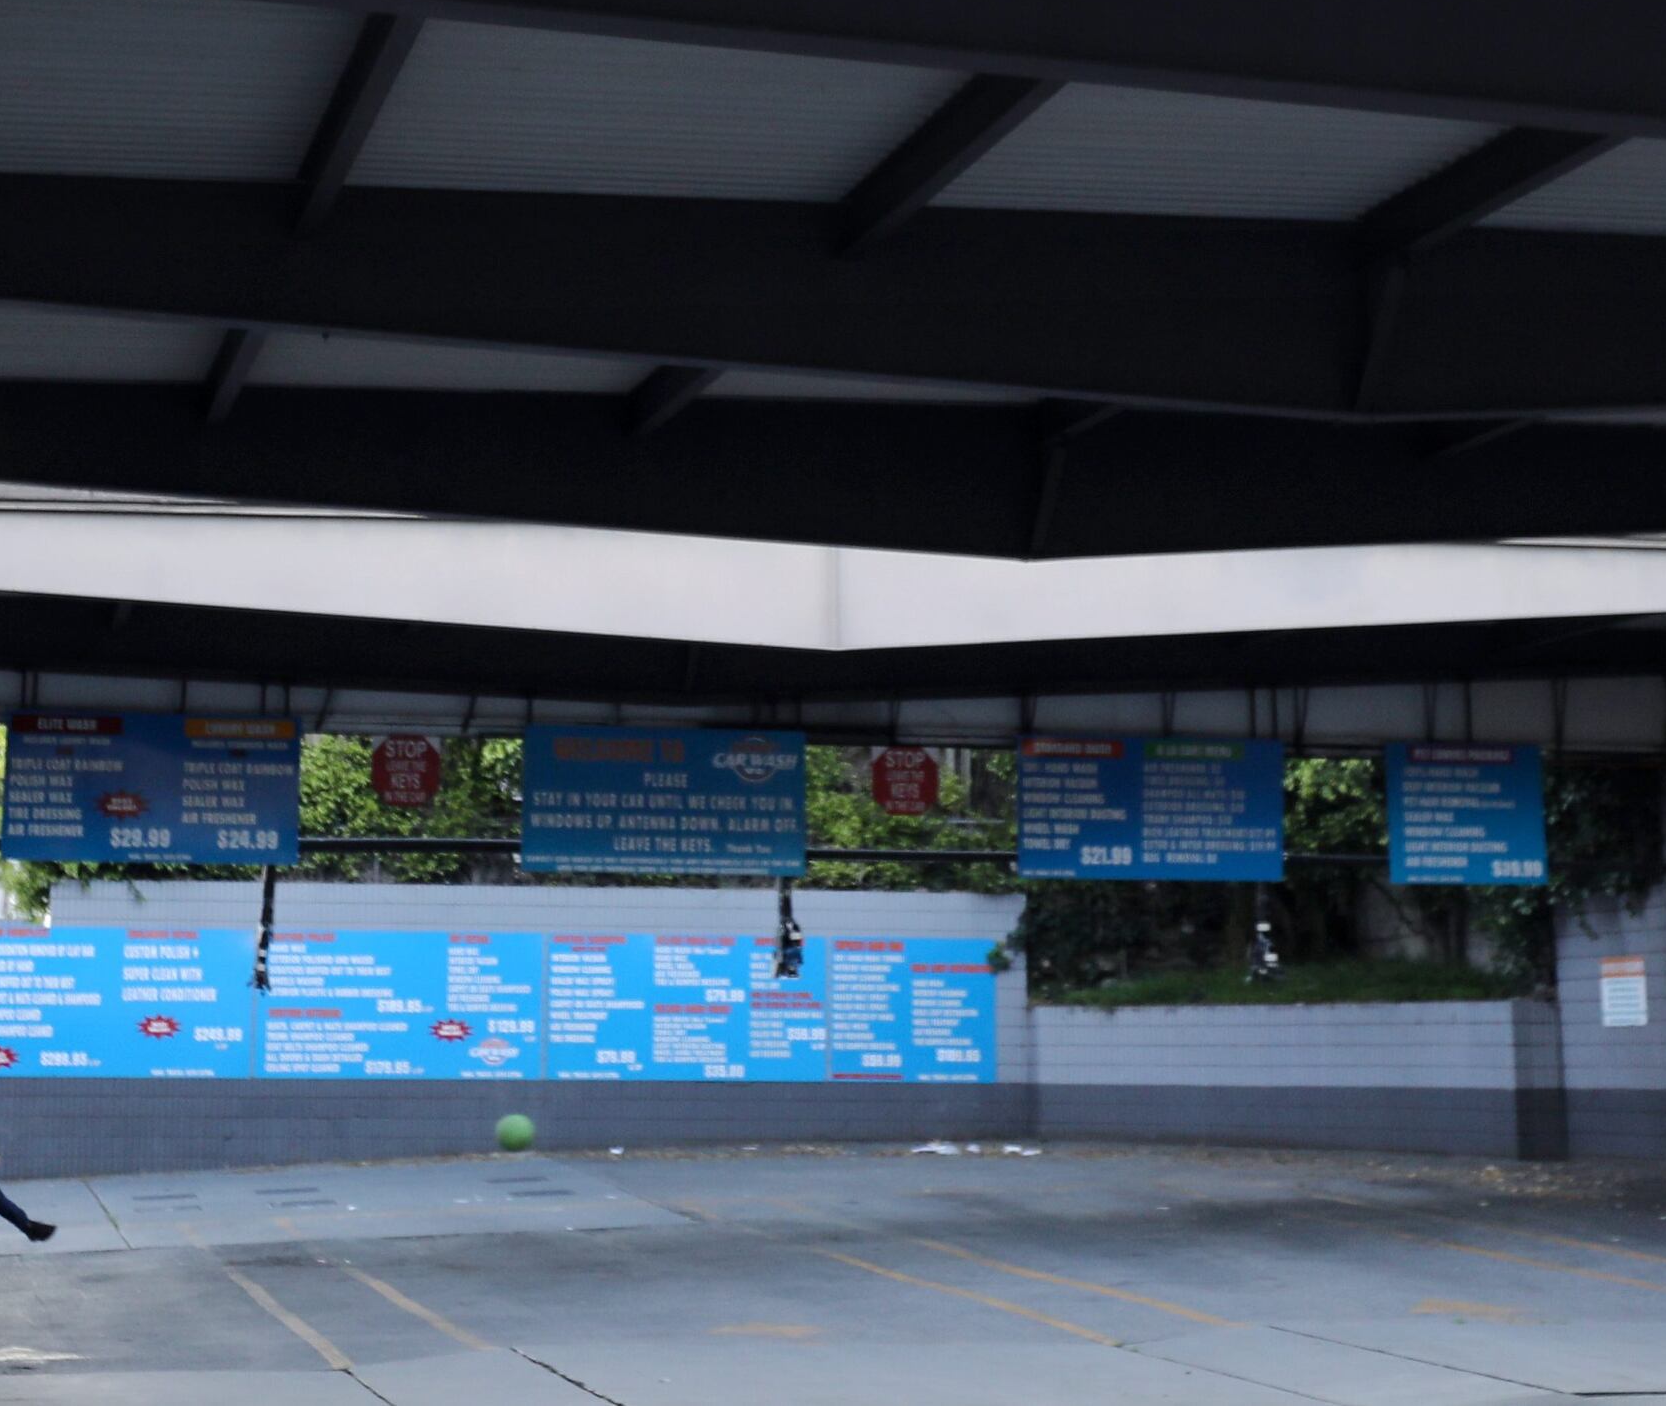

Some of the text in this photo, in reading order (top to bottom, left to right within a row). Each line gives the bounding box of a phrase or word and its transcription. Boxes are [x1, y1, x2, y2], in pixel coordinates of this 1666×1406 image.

[37, 718, 63, 730] ELITE
[385, 740, 427, 758] STOP
[885, 751, 926, 768] STOP
[643, 773, 688, 789] PLEASE
[532, 792, 563, 807] STAY
[567, 793, 582, 808] IN
[585, 793, 617, 808] YOUR
[621, 794, 645, 809] CAR
[688, 795, 708, 810] WE
[710, 796, 747, 811] CHECK
[752, 797, 776, 812] YOU
[531, 814, 592, 830] WINDOWS
[619, 815, 676, 831] ANTENNA
[728, 817, 771, 833] ALARM
[109, 826, 171, 848] $29.99
[217, 829, 279, 849] $24.99
[613, 836, 651, 851] LEAVE
[655, 837, 677, 852] THE
[1080, 846, 1133, 865] $21.99
